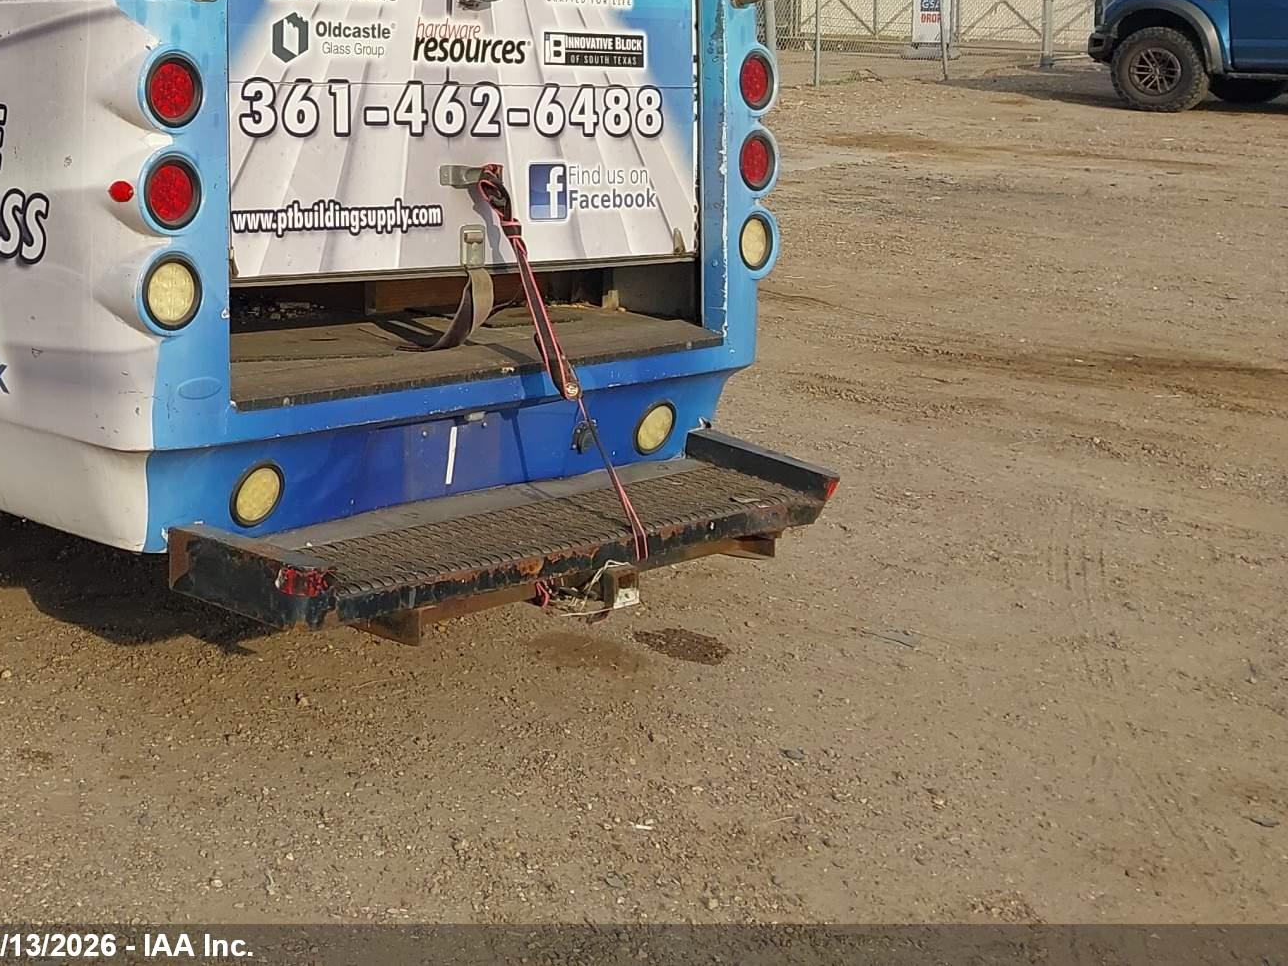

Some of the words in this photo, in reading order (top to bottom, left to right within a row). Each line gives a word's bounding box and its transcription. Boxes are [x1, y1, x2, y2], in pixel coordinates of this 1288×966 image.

[315, 20, 391, 40] Oldcastle
[416, 16, 481, 40] hardware
[322, 41, 352, 56] Glass
[354, 42, 385, 58] Group
[413, 34, 526, 64] resources
[565, 35, 613, 50] INNOVATIVE
[615, 36, 642, 51] BLOCK
[584, 55, 610, 65] SOUTH
[614, 55, 637, 66] TEXAS
[239, 78, 664, 137] 361-462-6488
[568, 165, 604, 186] Find
[608, 168, 625, 185] us
[630, 167, 649, 184] on
[569, 188, 657, 211] Facebook
[232, 199, 443, 237] www.ptbuildingsupply.com
